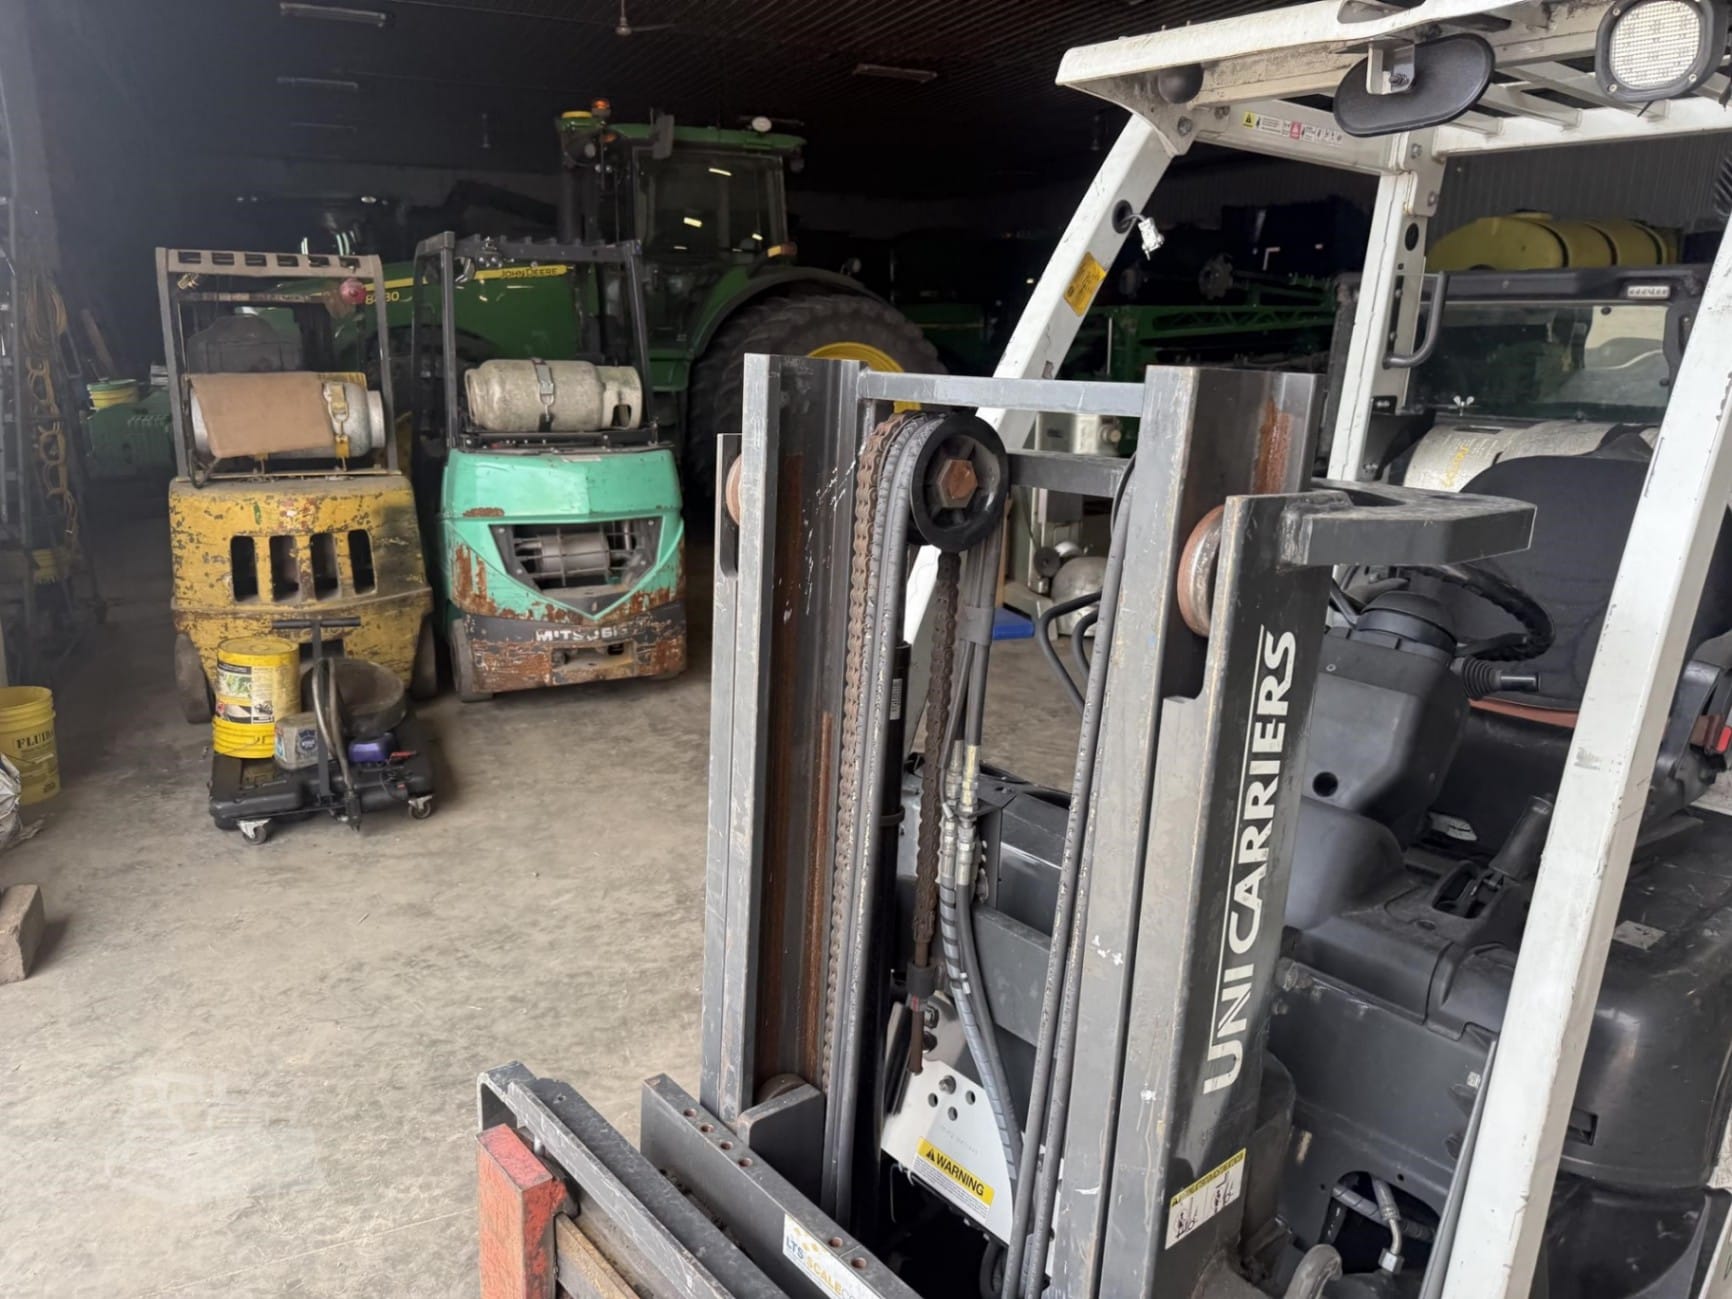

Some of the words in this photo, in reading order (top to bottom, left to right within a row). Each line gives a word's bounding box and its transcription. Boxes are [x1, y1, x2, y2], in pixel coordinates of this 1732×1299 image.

[502, 269, 526, 278] JOHN
[527, 267, 559, 277] DEERE
[365, 291, 400, 304] 830
[936, 1152, 985, 1196] WARNING
[786, 1235, 804, 1259] LTS
